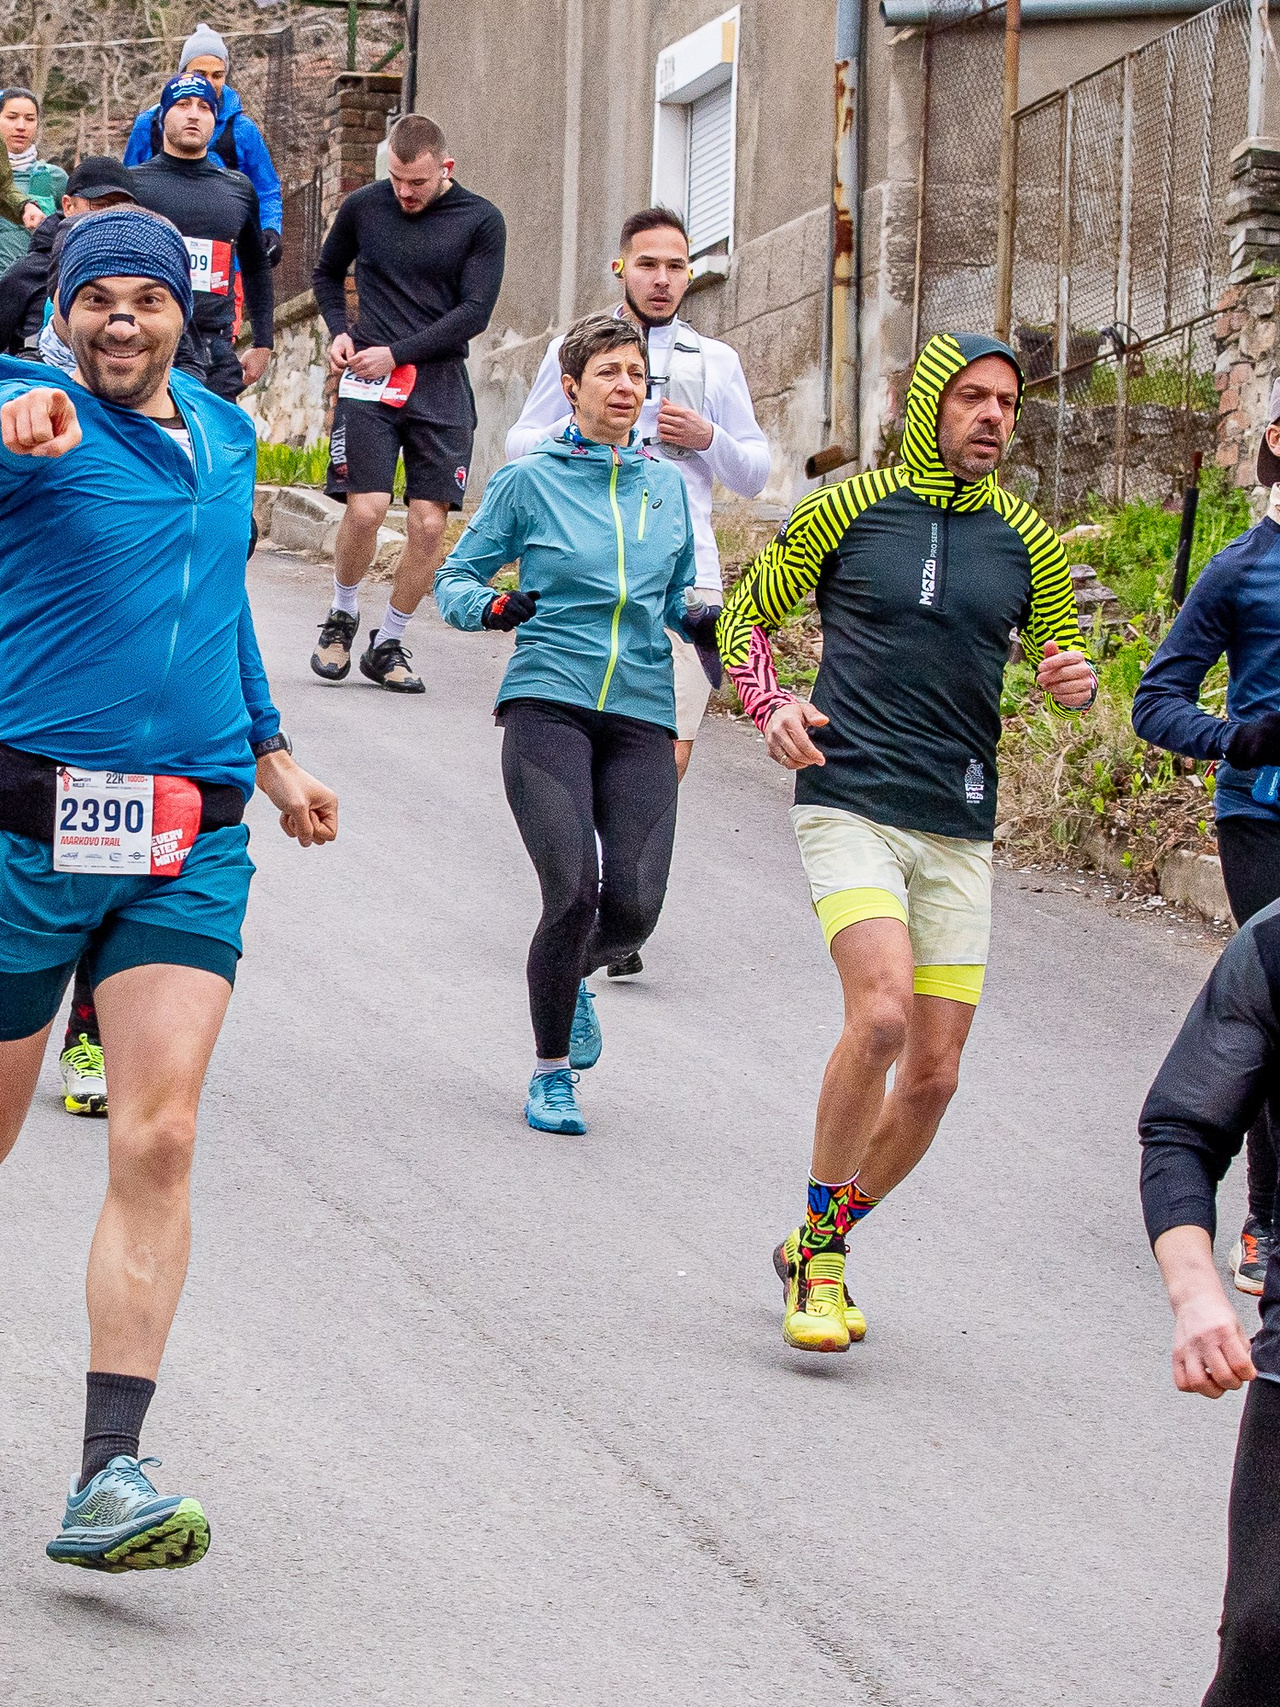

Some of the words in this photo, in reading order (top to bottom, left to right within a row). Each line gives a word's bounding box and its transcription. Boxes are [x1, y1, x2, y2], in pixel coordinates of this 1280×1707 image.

[930, 543, 938, 558] PRO
[105, 772, 125, 784] 22K
[60, 797, 144, 833] 2390
[60, 835, 99, 847] MARKOVO
[100, 836, 121, 847] TRAIL
[151, 840, 179, 857] STEP
